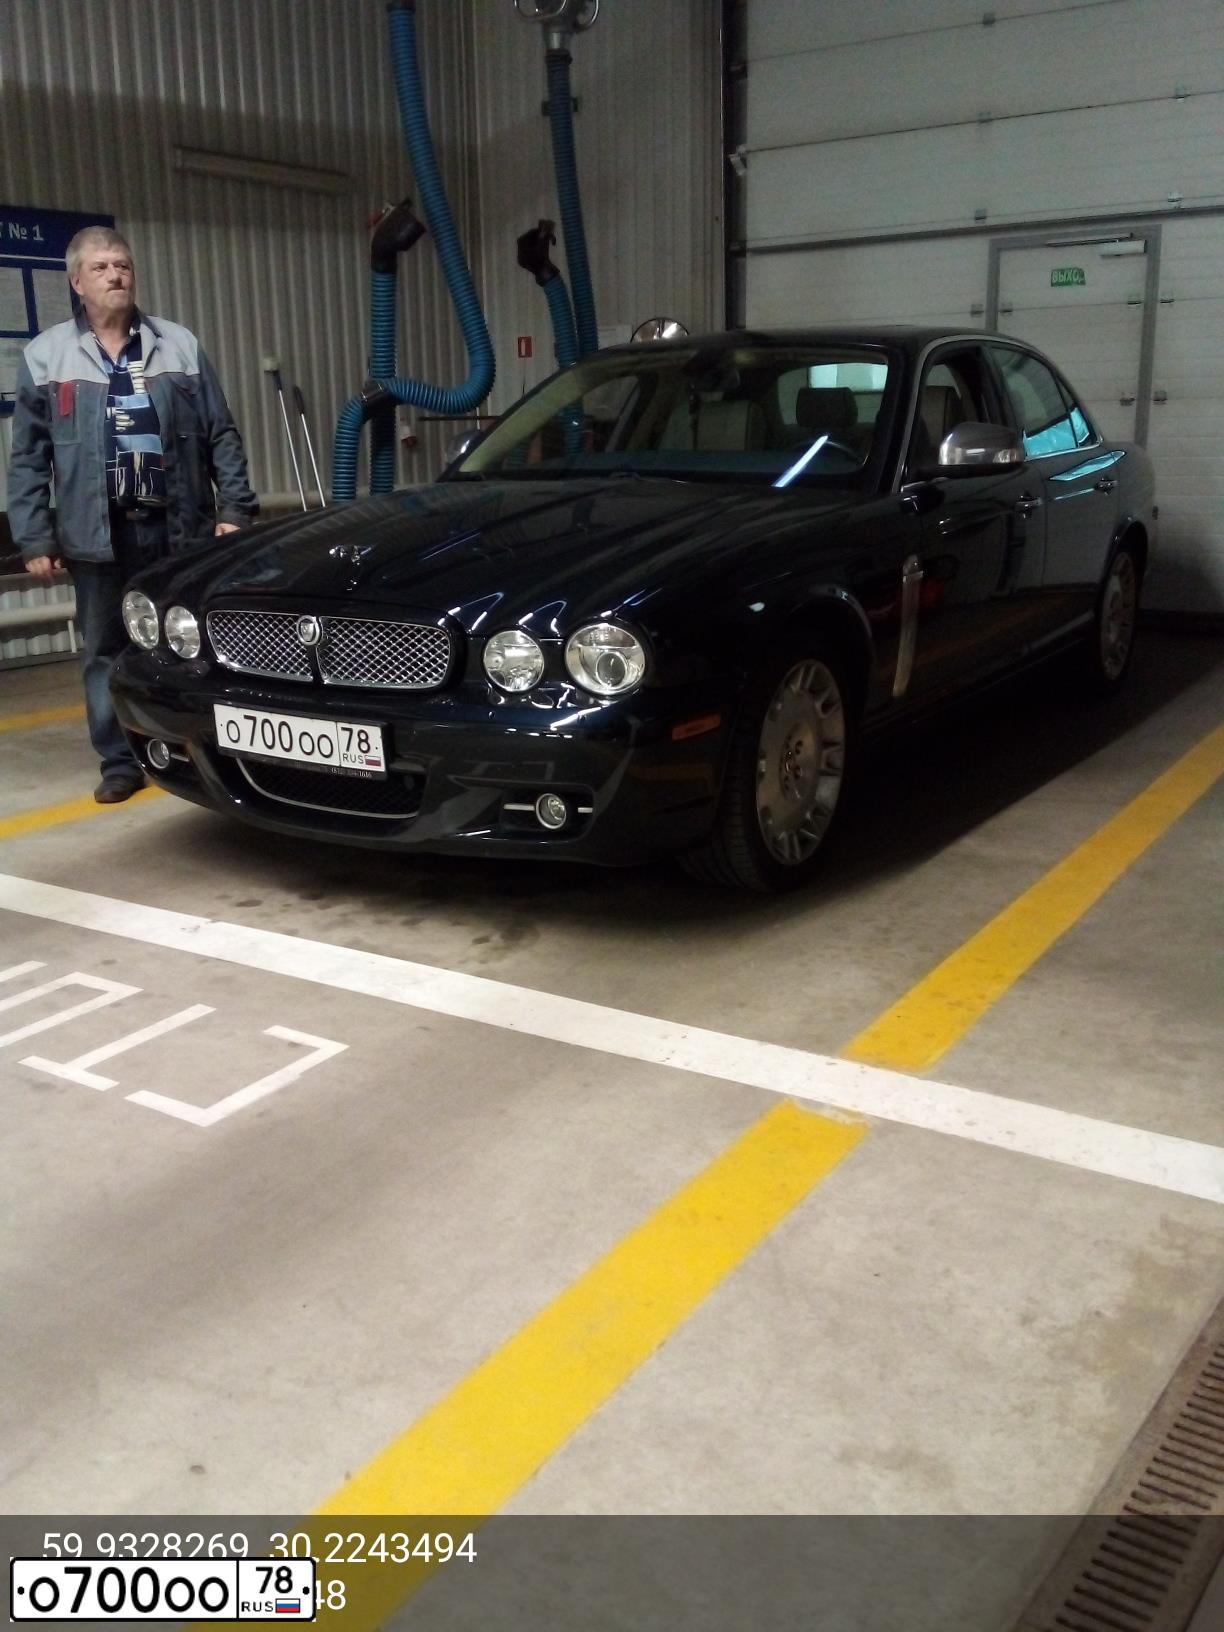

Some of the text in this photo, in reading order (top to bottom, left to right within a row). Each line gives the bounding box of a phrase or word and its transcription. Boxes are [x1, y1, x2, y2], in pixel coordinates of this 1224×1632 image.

[32, 224, 44, 241] 1
[340, 726, 371, 754] 78
[342, 753, 364, 765] RUS
